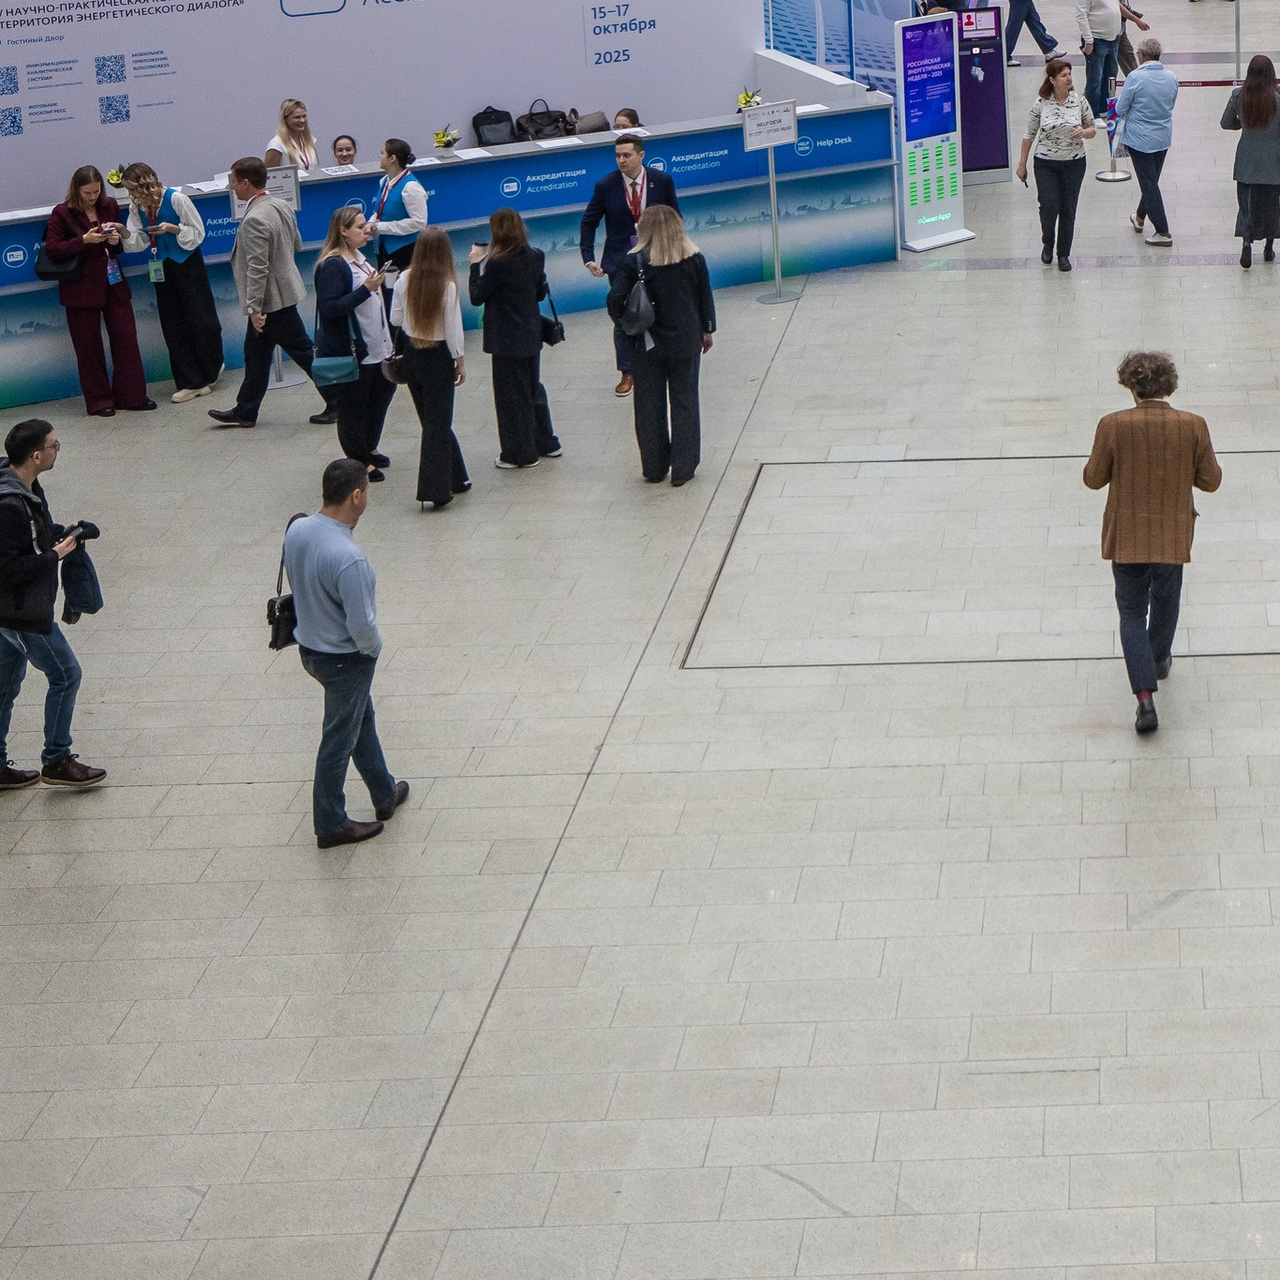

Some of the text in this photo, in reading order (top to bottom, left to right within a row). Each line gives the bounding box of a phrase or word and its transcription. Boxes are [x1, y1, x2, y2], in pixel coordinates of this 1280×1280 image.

[0, 0, 245, 29] ТЕРРИТОРИЯ ЭНЕРГЕТИЧЕСКОГО ДИАЛОГА»
[593, 19, 656, 35] октября
[7, 34, 64, 46] Гостиный Двор
[595, 49, 630, 64] 2025
[835, 136, 852, 144] Desk
[671, 149, 728, 163] Аккредитация
[672, 160, 720, 172] Accreditation
[526, 169, 586, 182] Аккредитация
[526, 181, 577, 193] Accreditation
